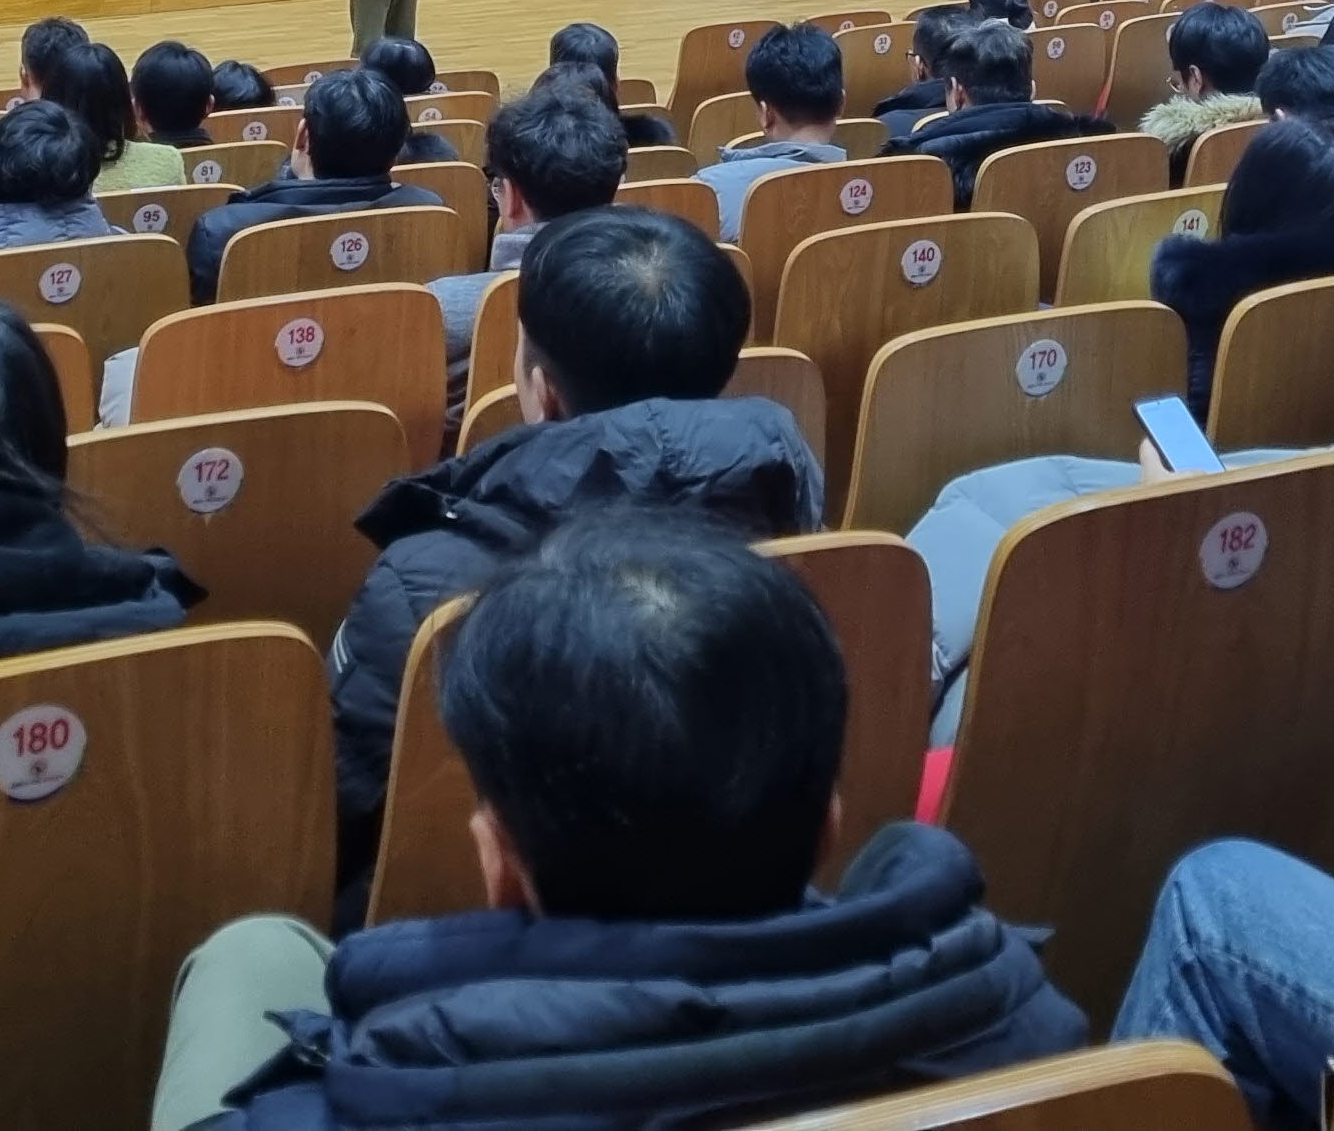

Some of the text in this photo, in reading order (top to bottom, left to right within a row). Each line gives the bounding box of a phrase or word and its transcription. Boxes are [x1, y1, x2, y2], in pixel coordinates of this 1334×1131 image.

[249, 127, 262, 136] 53
[200, 166, 214, 177] 81
[1075, 161, 1091, 174] 123
[848, 185, 867, 198] 124
[142, 210, 161, 223] 95
[1182, 217, 1201, 231] 141
[340, 239, 363, 253] 126
[911, 247, 935, 265] 140
[49, 269, 73, 285] 127
[288, 325, 316, 345] 138
[1028, 348, 1058, 369] 170
[194, 459, 230, 484] 172
[1220, 523, 1256, 554] 182
[13, 718, 70, 757] 180
